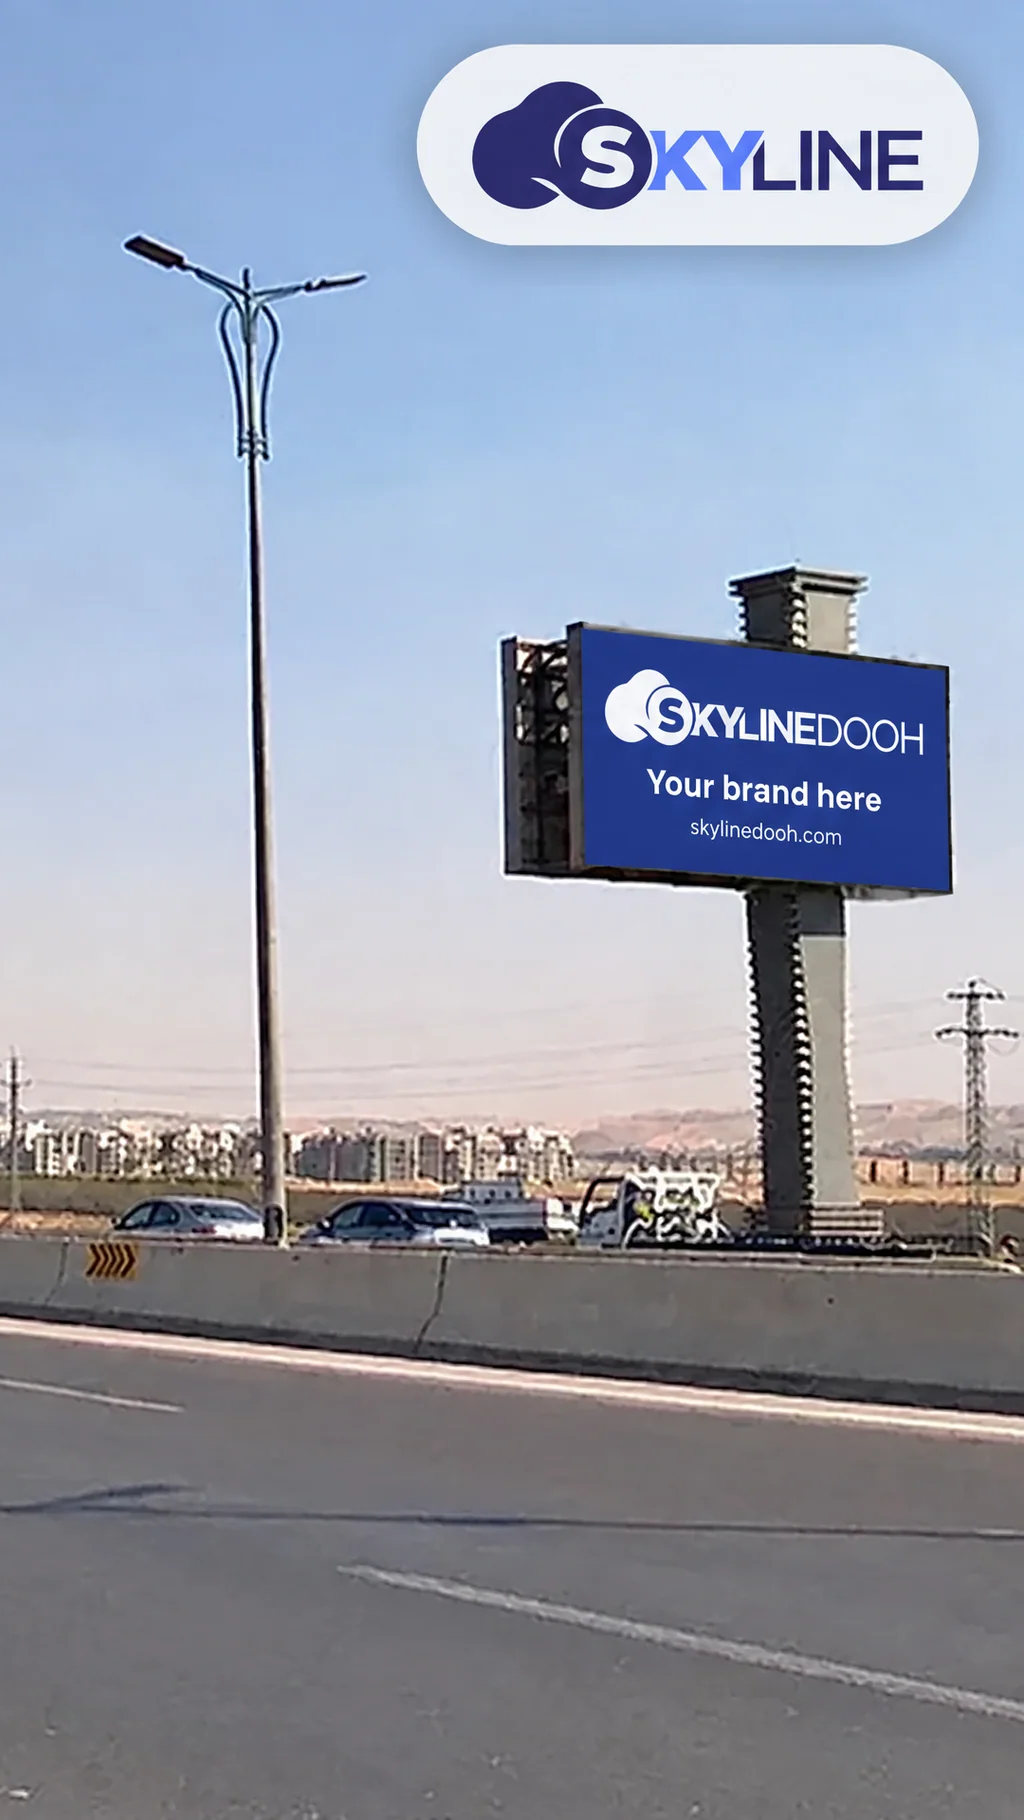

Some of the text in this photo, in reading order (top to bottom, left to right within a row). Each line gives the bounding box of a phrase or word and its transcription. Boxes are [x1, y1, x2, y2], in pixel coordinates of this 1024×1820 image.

[658, 697, 924, 756] SKYLINEDOOH
[647, 768, 882, 812] Your brand here
[690, 818, 842, 846] skylinedooh.com
